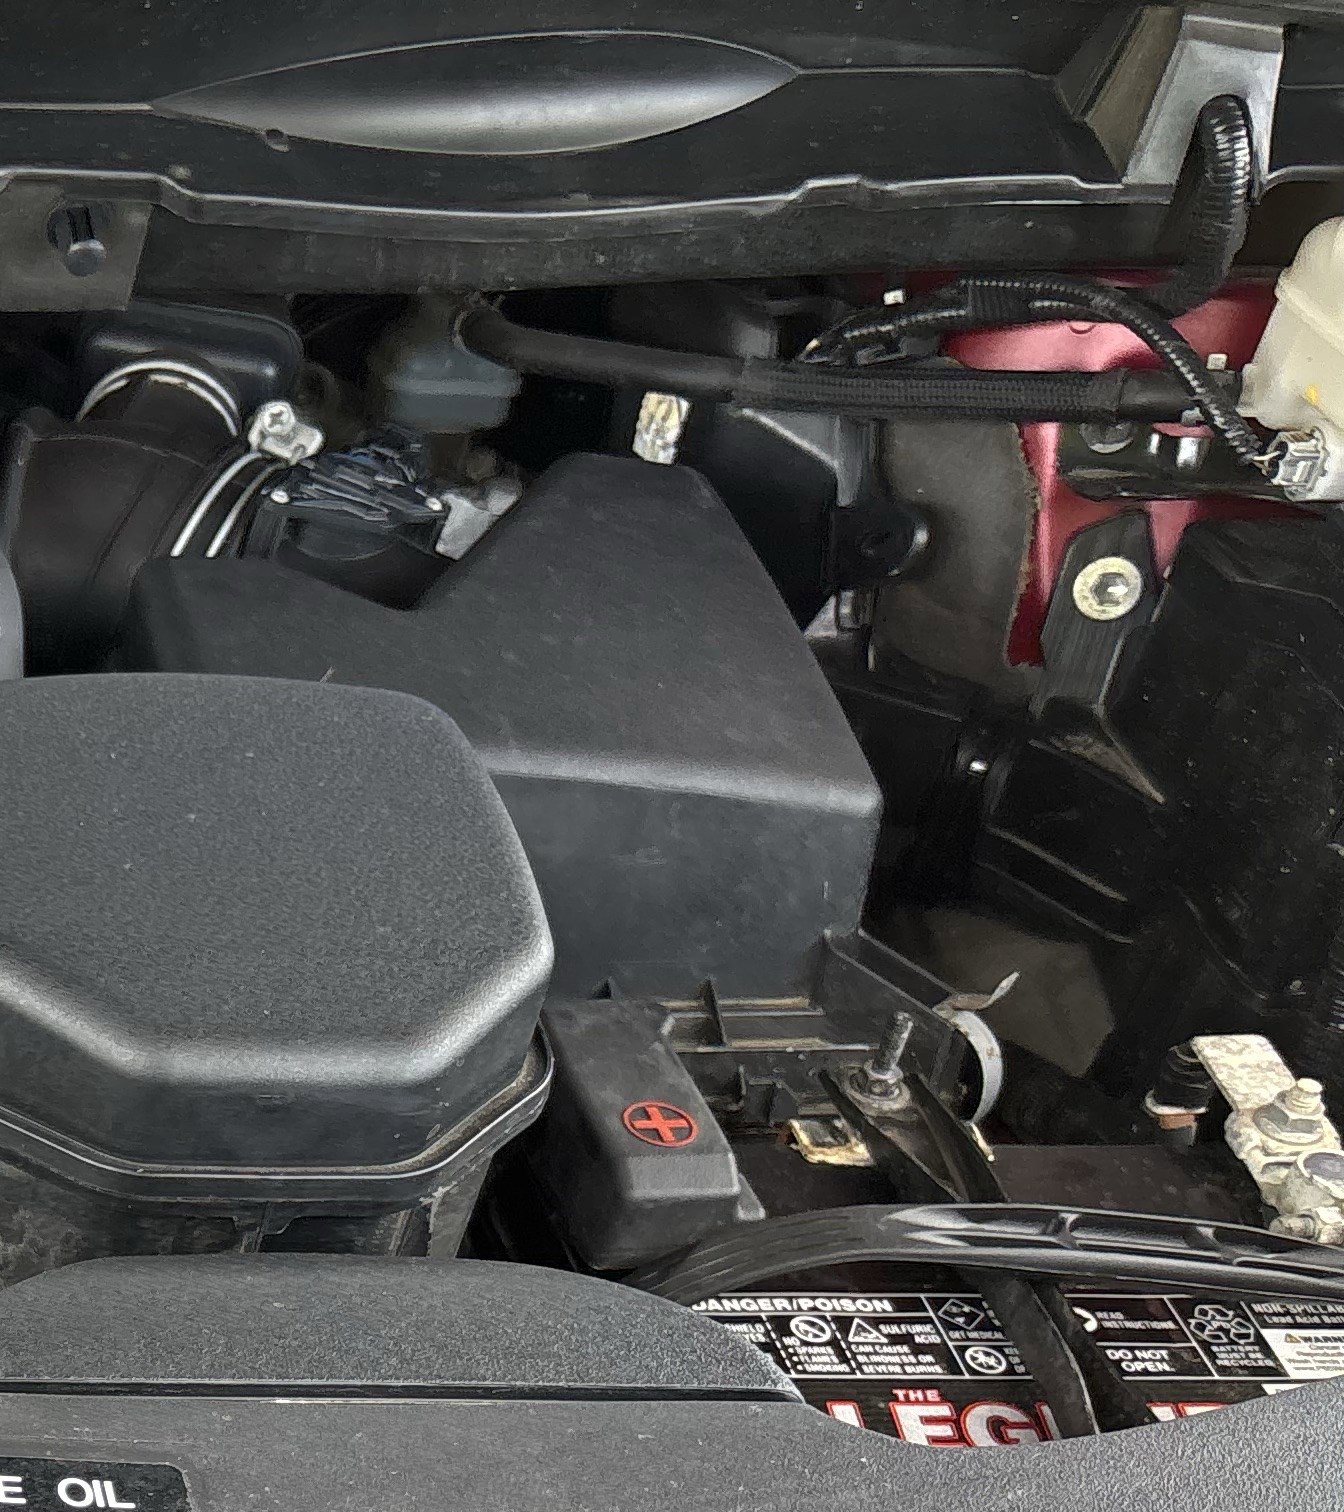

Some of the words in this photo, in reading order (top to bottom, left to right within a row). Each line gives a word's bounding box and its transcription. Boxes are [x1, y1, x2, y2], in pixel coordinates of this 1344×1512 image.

[879, 1323, 937, 1335] SULFURIC
[782, 1336, 801, 1347] NO
[914, 1334, 942, 1344] ACID
[851, 1344, 875, 1353] CAN
[875, 1344, 911, 1354] CAUSE
[1105, 1349, 1133, 1361] DO
[1134, 1349, 1171, 1361] NOT
[892, 1388, 942, 1401] THE
[57, 1478, 136, 1509] OIL
